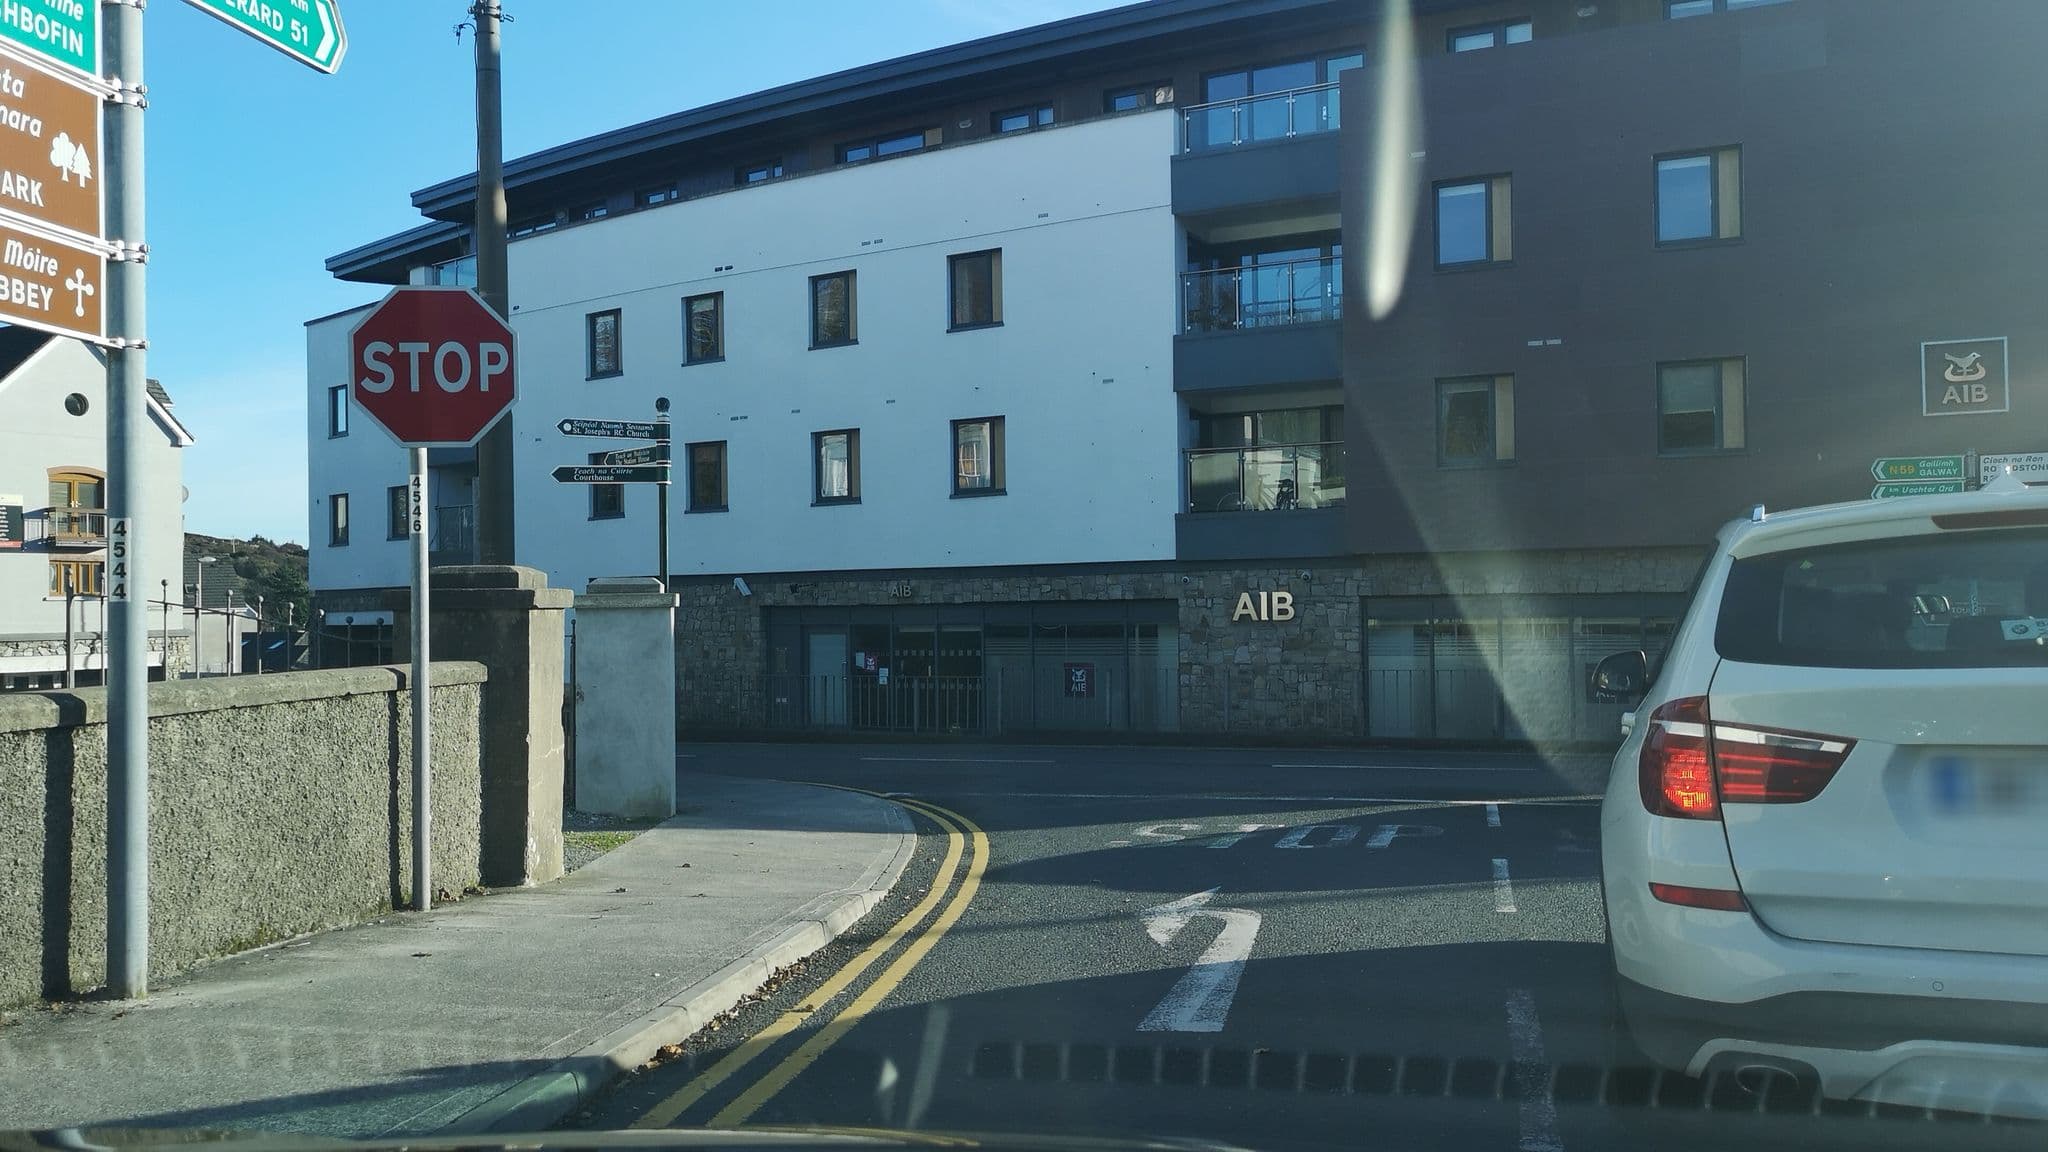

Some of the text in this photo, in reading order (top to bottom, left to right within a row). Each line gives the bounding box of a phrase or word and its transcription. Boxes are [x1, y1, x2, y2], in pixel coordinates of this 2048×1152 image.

[0, 0, 83, 57] HBOFIN
[291, 18, 308, 47] 51
[0, 69, 24, 98] ta
[361, 341, 509, 393] STOP
[1942, 384, 1988, 404] AIB
[627, 430, 650, 438] Church
[1919, 460, 1953, 468] Gaillimh
[1919, 468, 1958, 476] GALWAY
[1984, 463, 2048, 473] RODSTON
[574, 473, 614, 481] Courthouse
[1902, 486, 1936, 494] Uachtar
[1938, 485, 1954, 493] Ard
[412, 476, 422, 532] 4546
[111, 520, 127, 600] 4544
[890, 585, 912, 597] AIB
[1232, 591, 1296, 621] AIB
[1109, 823, 1444, 849] STOP
